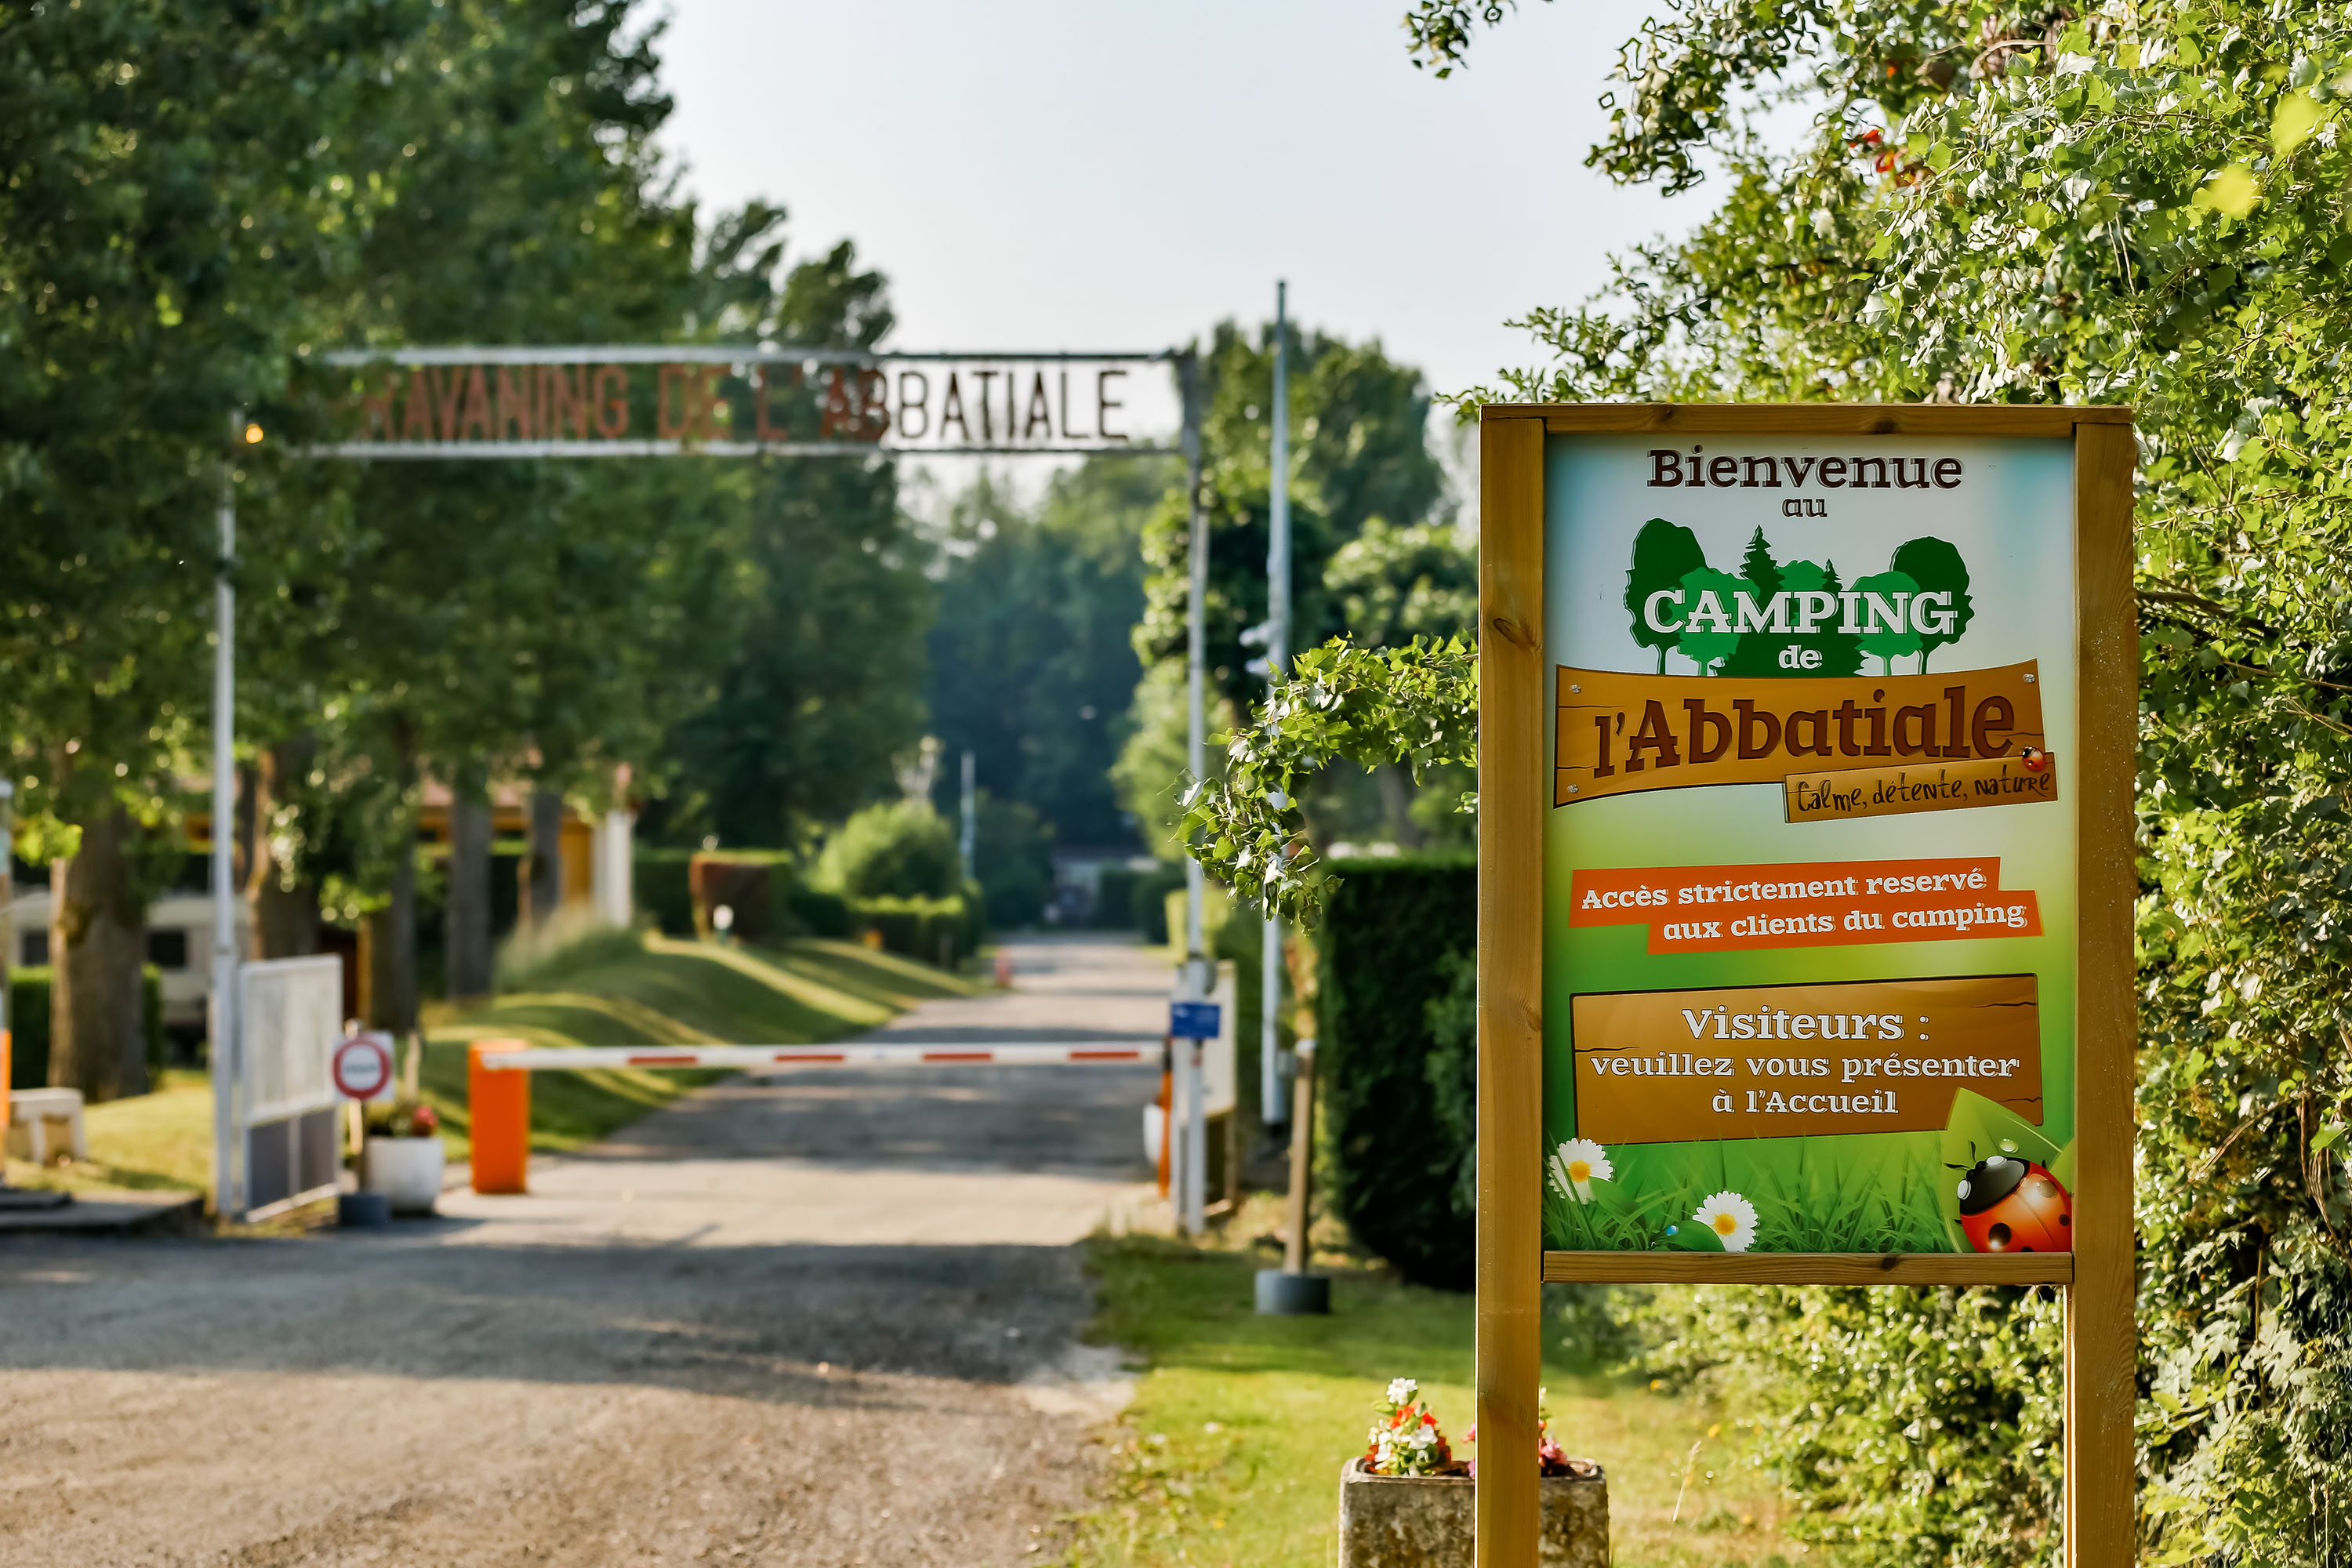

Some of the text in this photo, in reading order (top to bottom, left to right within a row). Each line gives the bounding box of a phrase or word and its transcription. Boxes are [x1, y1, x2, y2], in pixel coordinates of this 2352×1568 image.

[1647, 445, 1962, 490] Bienvenue
[1782, 495, 1828, 517] au
[1644, 590, 1958, 634] CAMPING
[1778, 645, 1822, 670] de
[1593, 685, 2014, 779] l'Abbatiale
[1797, 778, 1867, 813] Calme,
[1581, 868, 1987, 910] Accès strictement reservé
[1663, 902, 2027, 941] aux clients du camping
[1682, 1005, 1929, 1040] Visiteurs :
[1591, 1051, 2020, 1085] veuillez vous présenter
[1711, 1090, 1900, 1115] à l'Accueil
